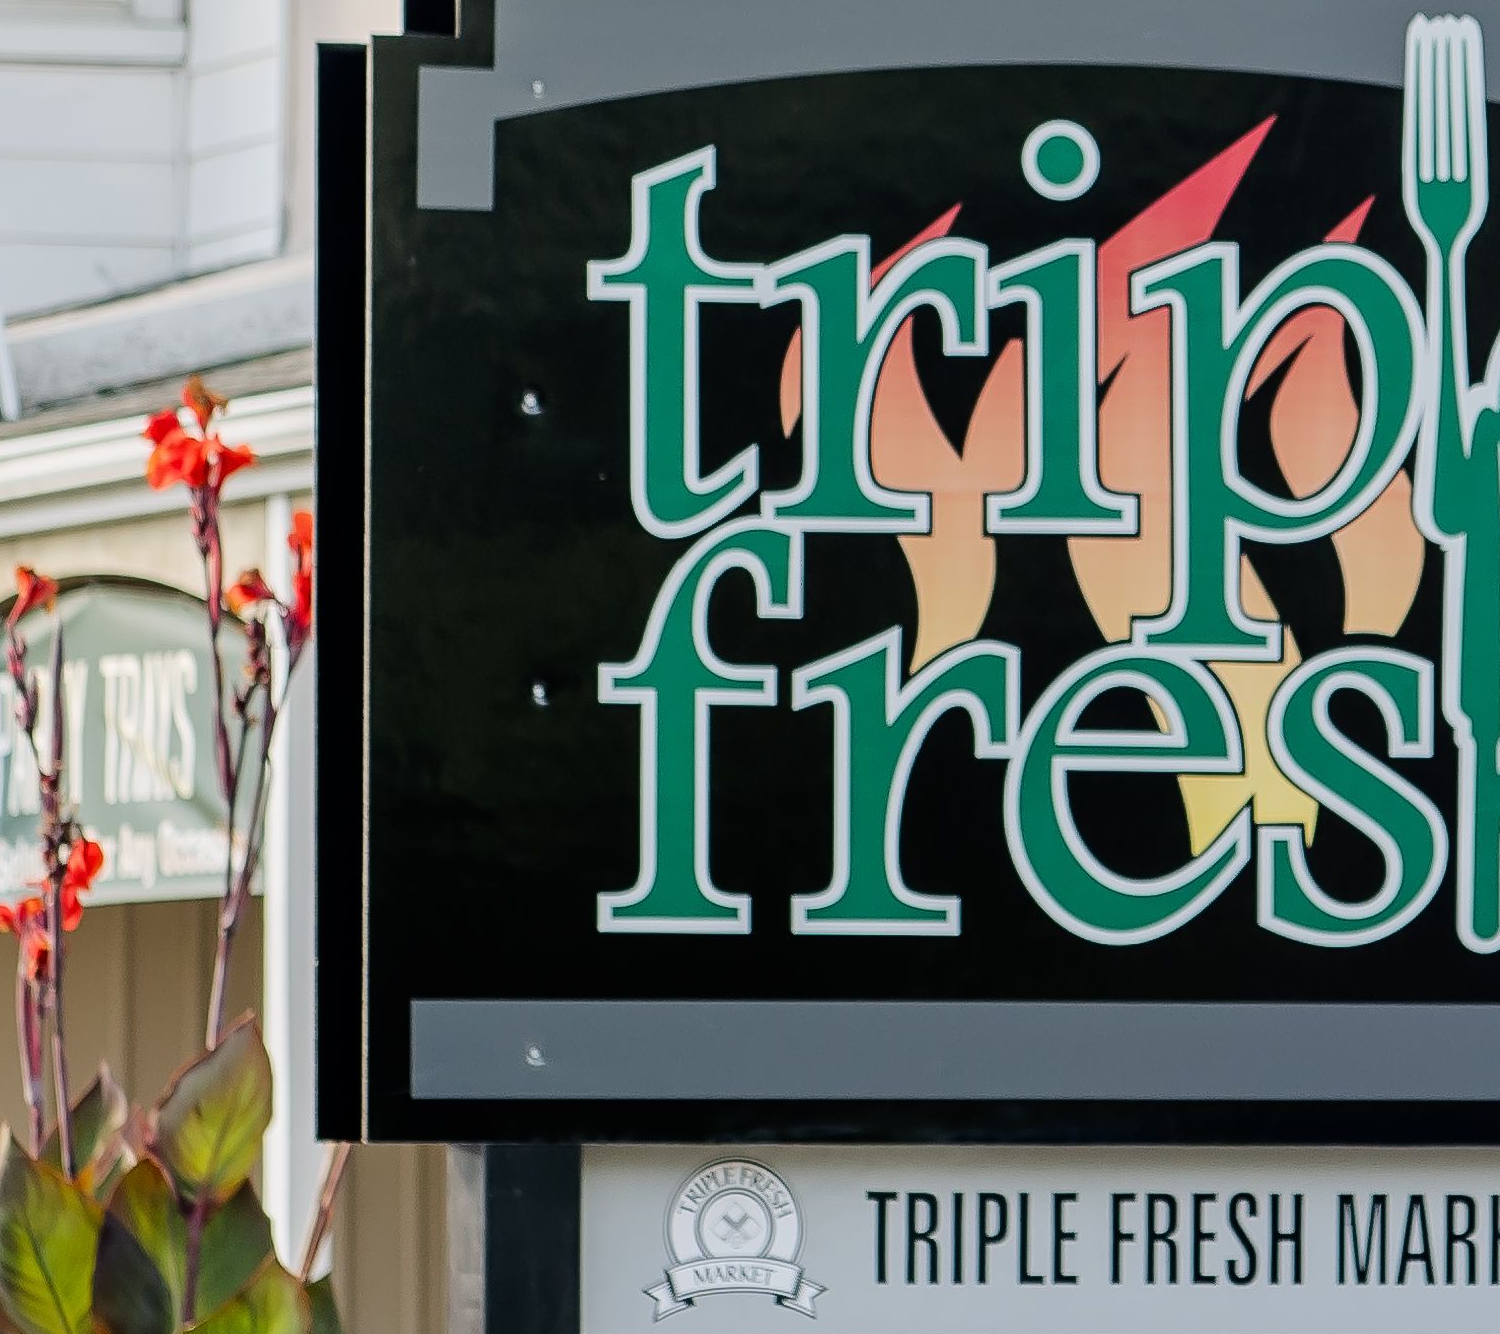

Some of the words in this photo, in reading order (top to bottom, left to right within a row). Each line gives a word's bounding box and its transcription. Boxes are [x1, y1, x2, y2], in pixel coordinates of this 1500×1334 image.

[867, 1190, 1080, 1288] TRIPLE
[1108, 1190, 1305, 1288] FRESH
[693, 1264, 777, 1286] MARKET
